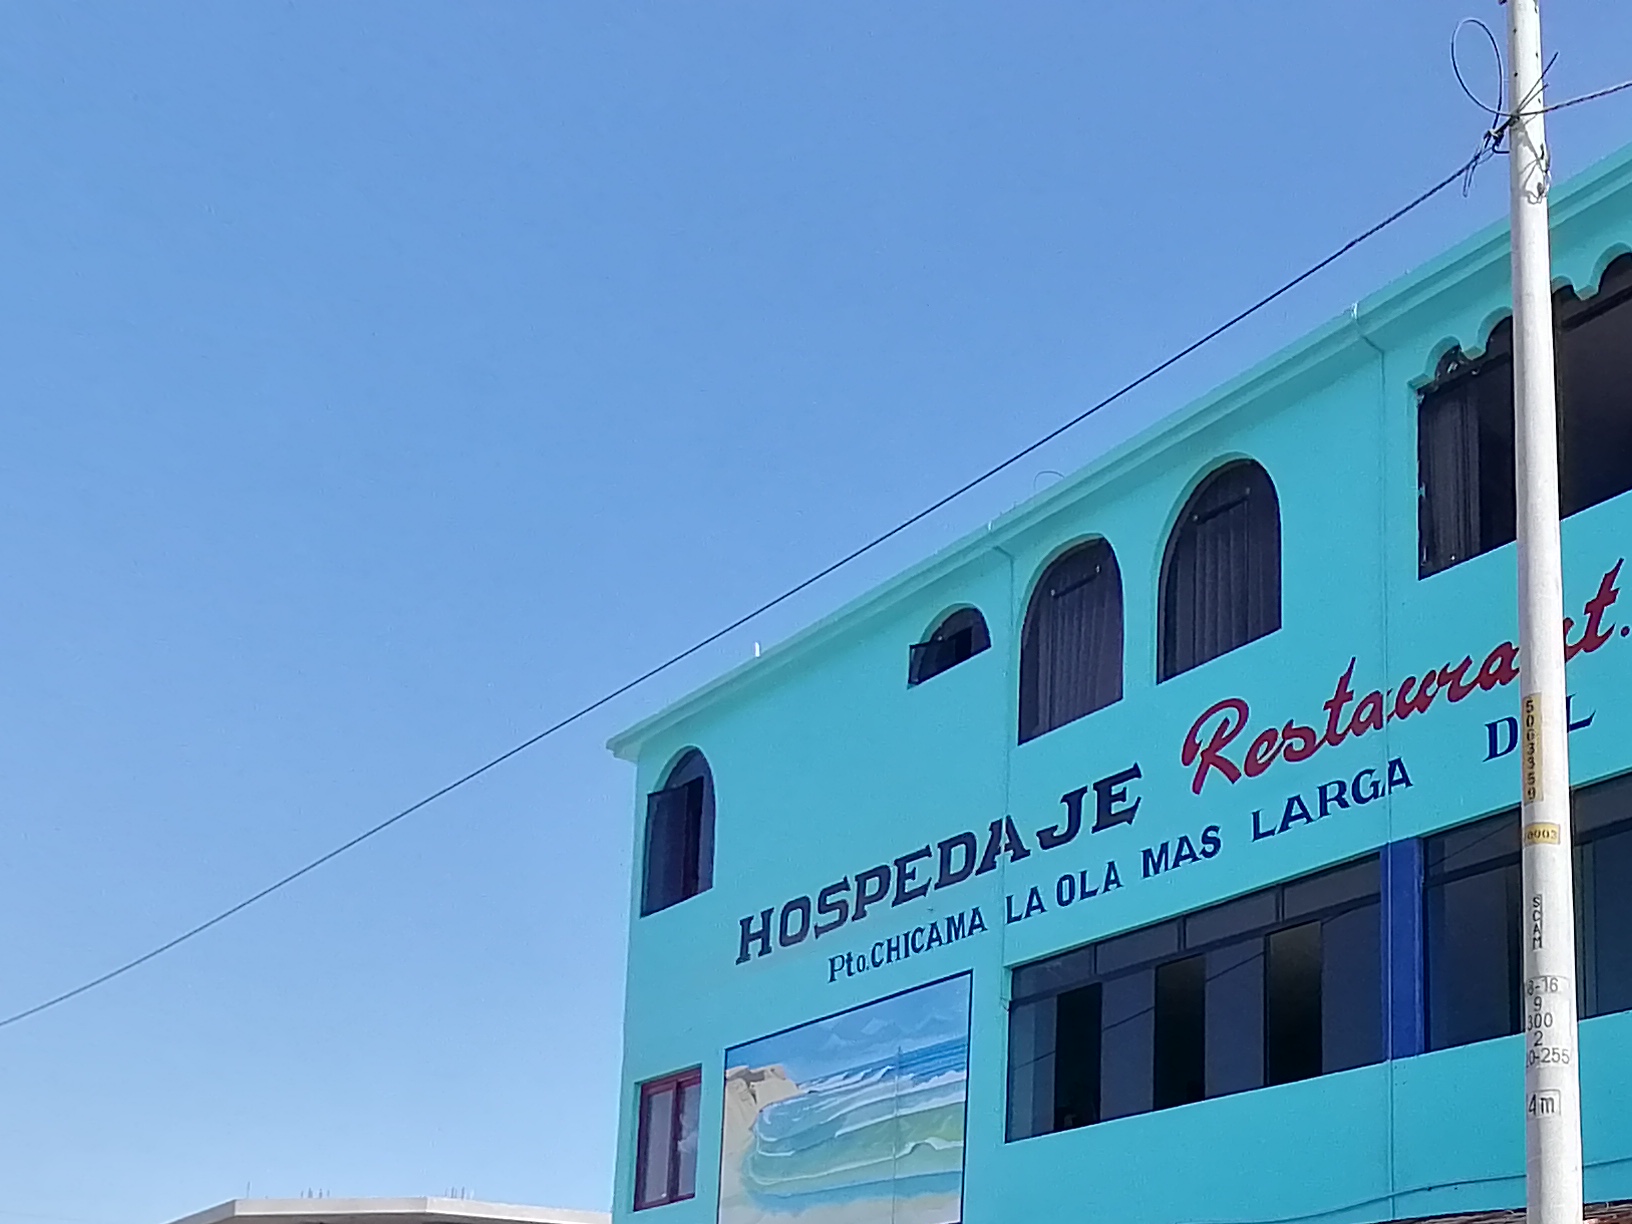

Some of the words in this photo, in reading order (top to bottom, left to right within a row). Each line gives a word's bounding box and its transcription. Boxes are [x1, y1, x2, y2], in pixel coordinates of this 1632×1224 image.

[735, 762, 1142, 966] HOSPEDAJE
[1005, 885, 1048, 926] LA
[1056, 860, 1124, 908] OLA
[1140, 825, 1222, 880] MAS
[1250, 756, 1414, 843] LARGA
[1483, 692, 1597, 763] DL
[1533, 996, 1542, 1012] 9
[1533, 1030, 1544, 1047] 2
